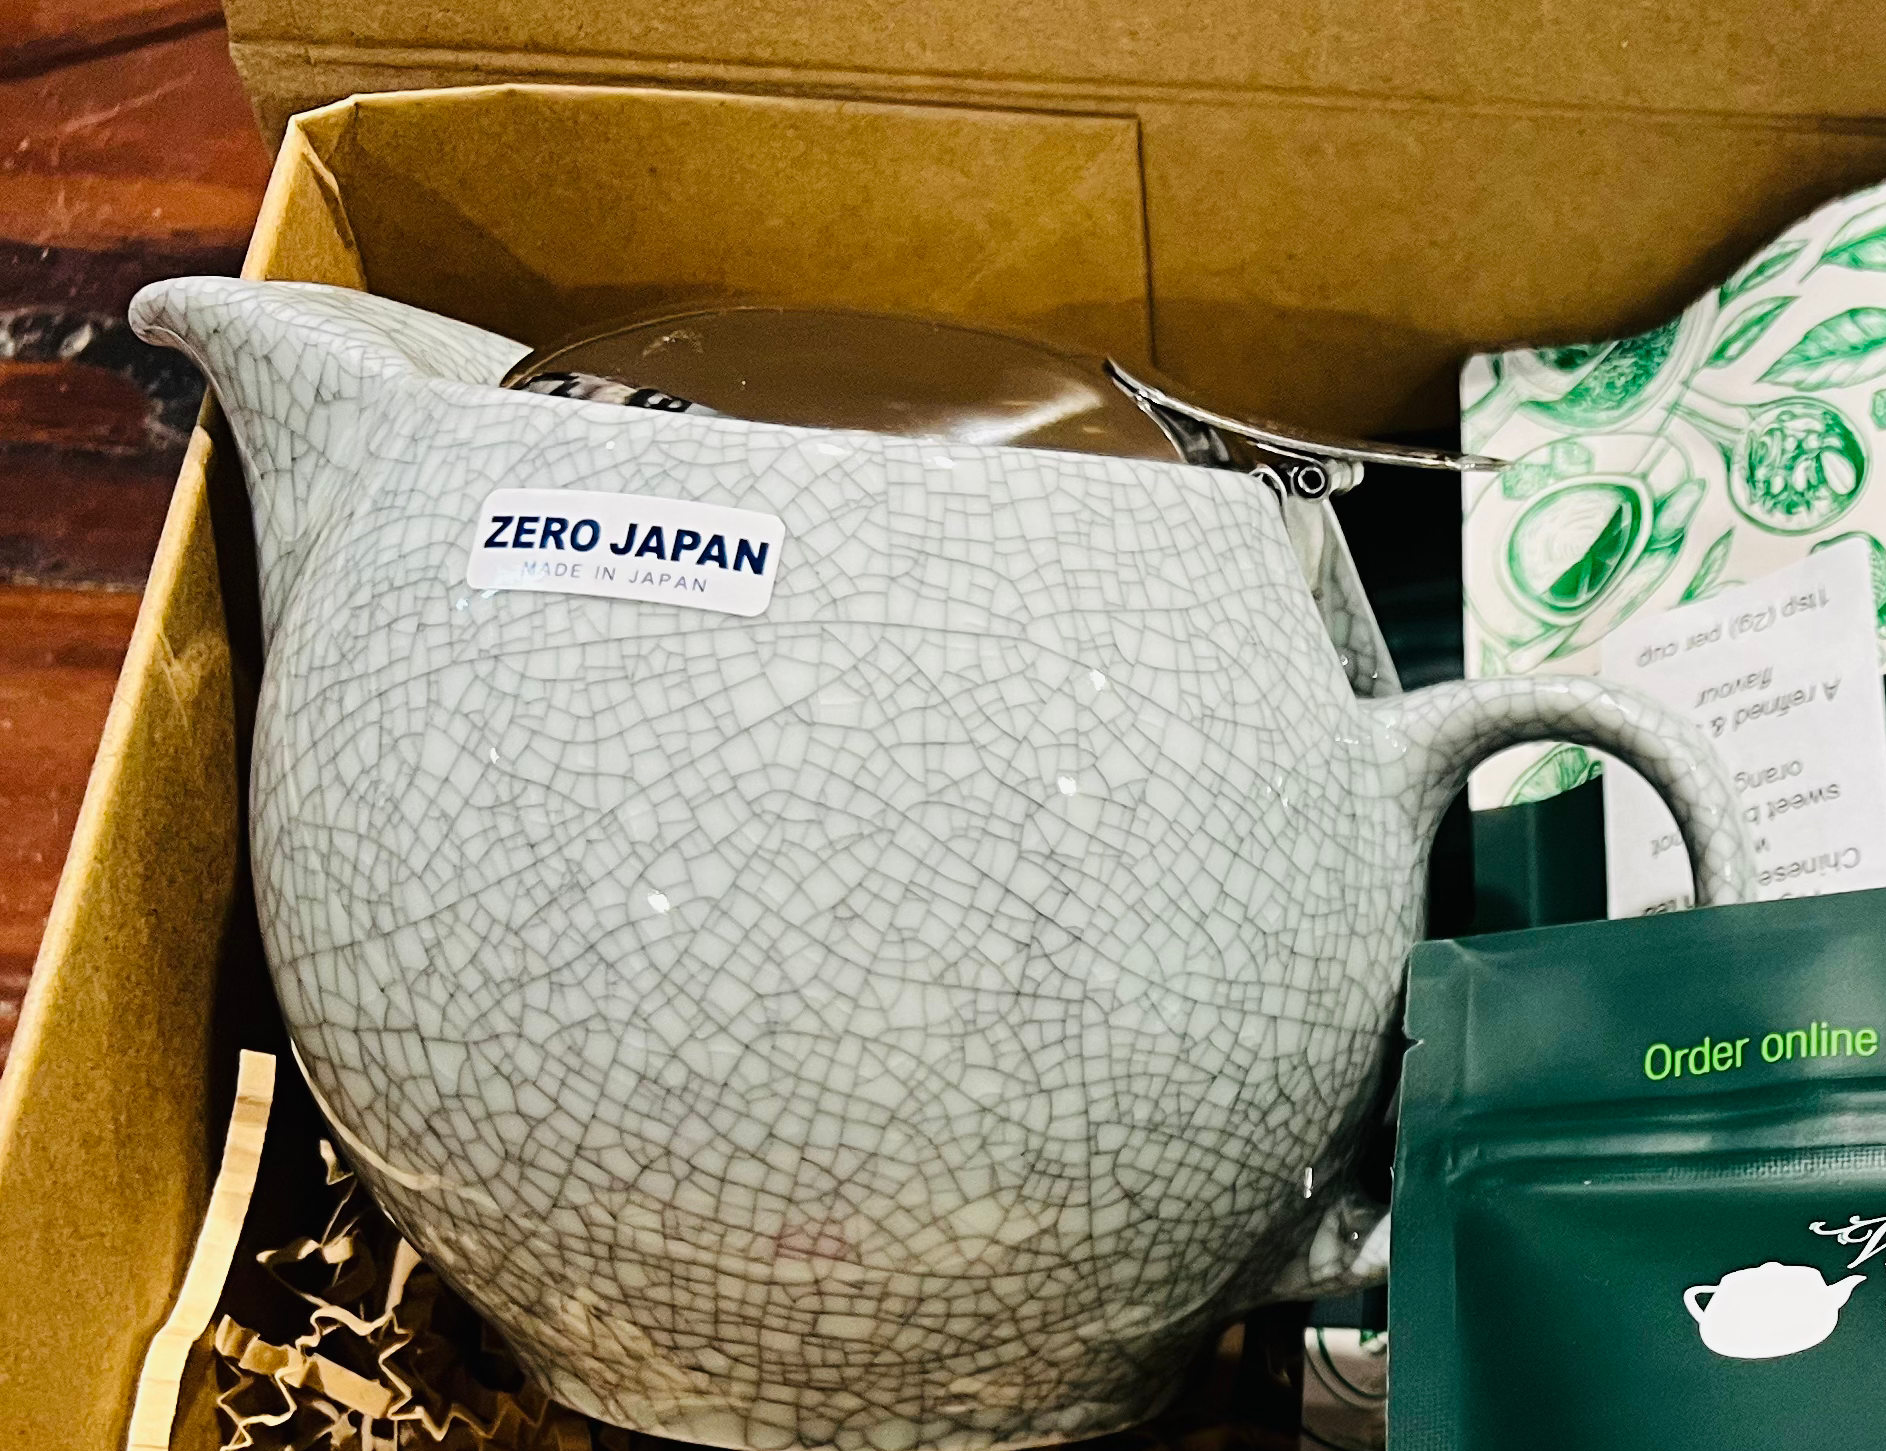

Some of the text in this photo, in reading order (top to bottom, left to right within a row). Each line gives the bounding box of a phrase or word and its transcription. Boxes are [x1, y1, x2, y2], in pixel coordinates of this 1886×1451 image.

[483, 515, 769, 576] ZERO JAPAN
[522, 561, 707, 592] MADE IN JAPAN
[1636, 586, 1830, 668] 1tsp (2g) per cup
[1694, 666, 1774, 708] flavour
[1711, 677, 1842, 737] A refined &
[1768, 783, 1841, 821] sweet
[1758, 847, 1861, 886] Chinese
[1644, 1035, 1749, 1081] Order
[1760, 1022, 1877, 1064] online
